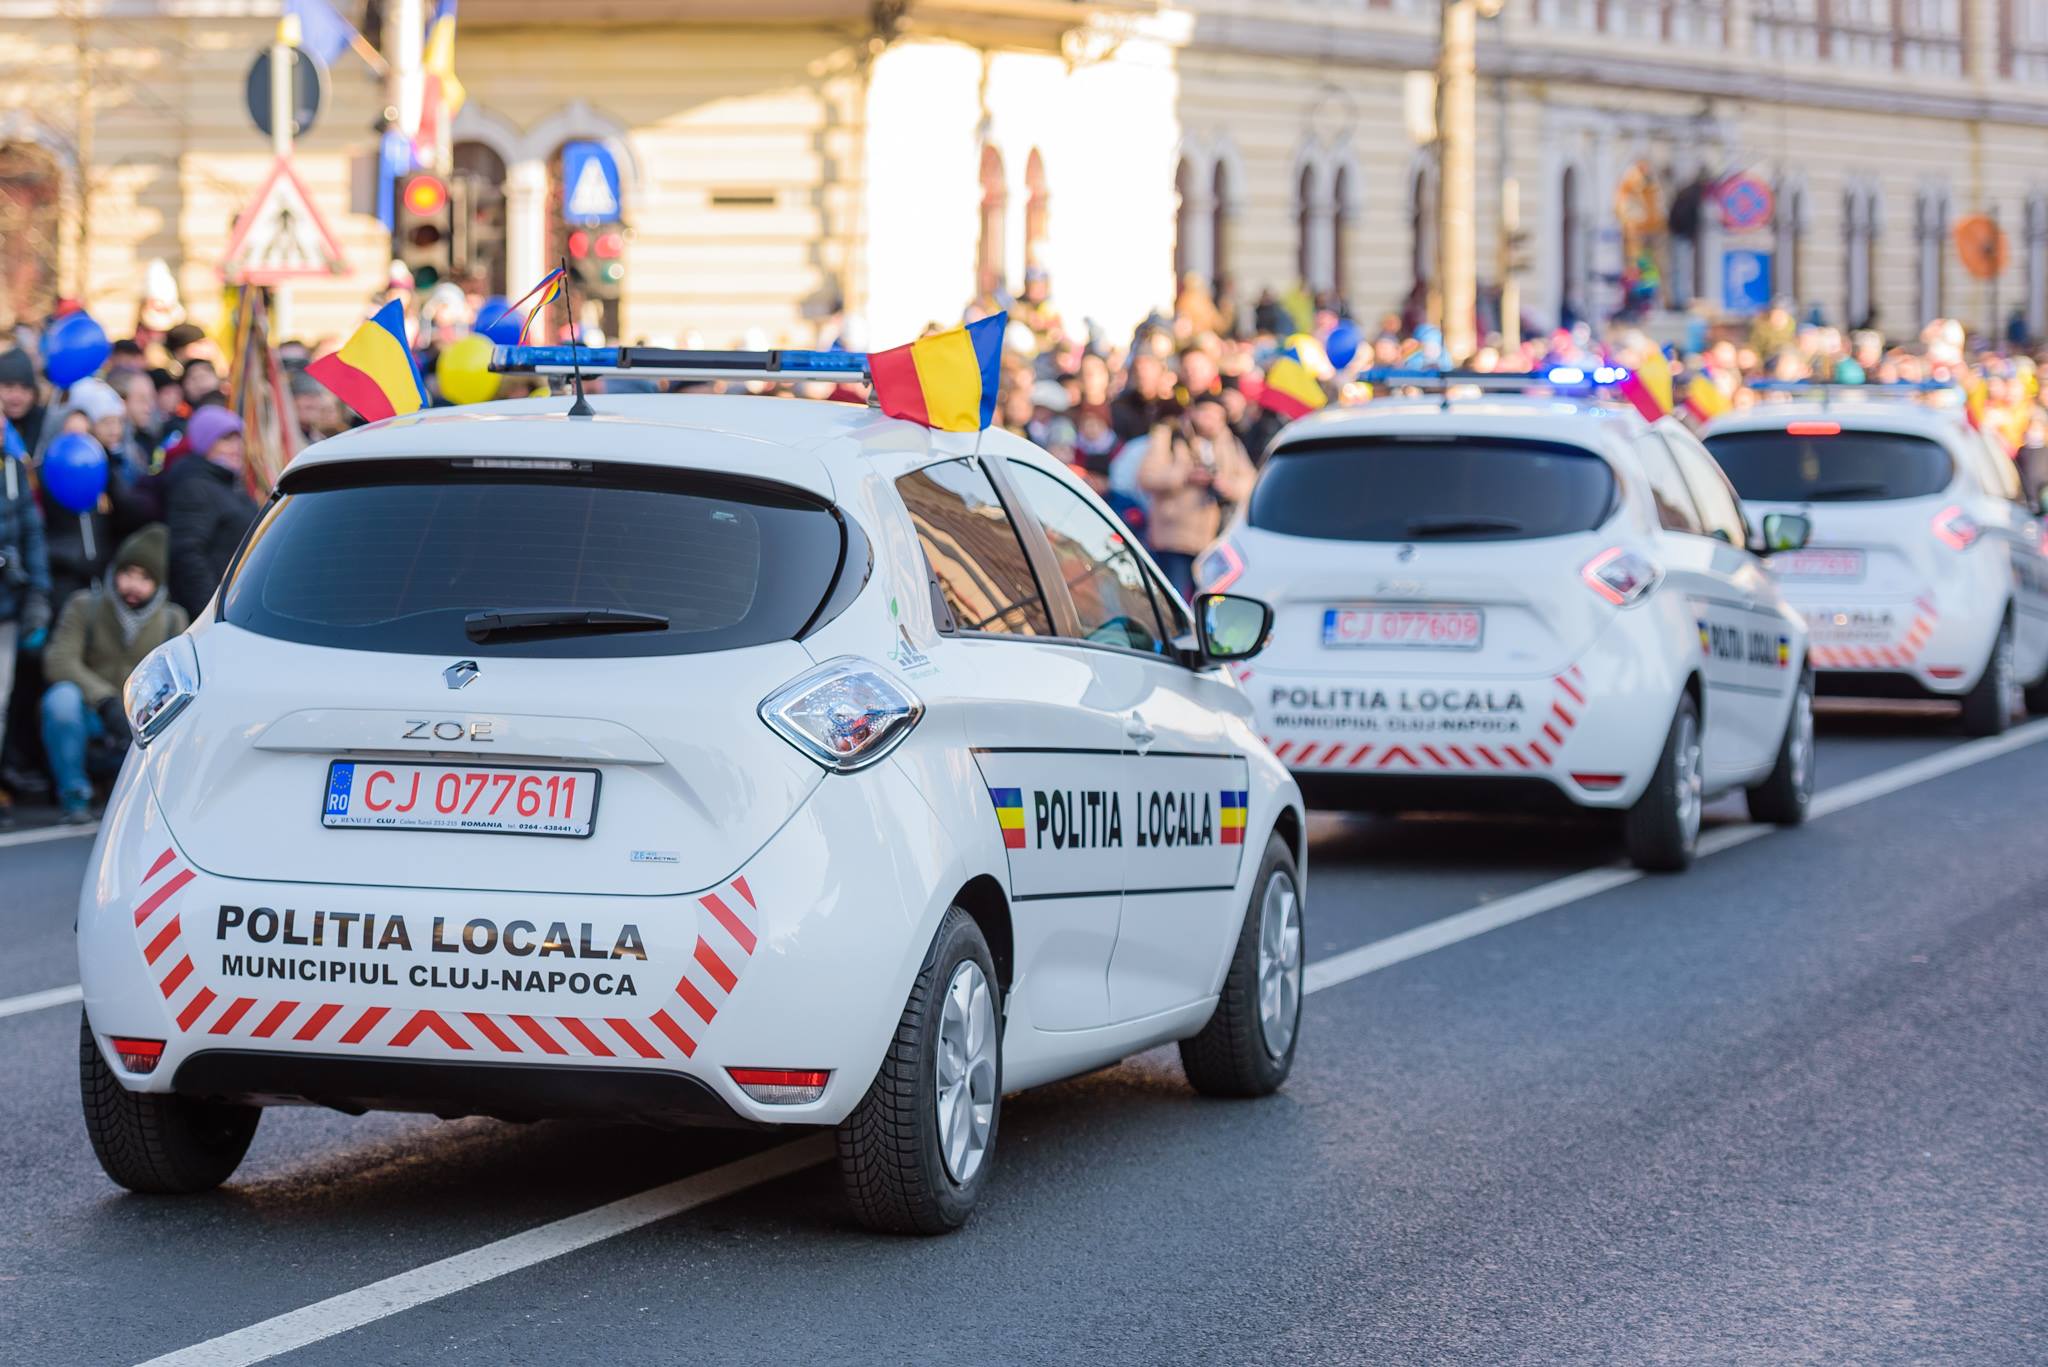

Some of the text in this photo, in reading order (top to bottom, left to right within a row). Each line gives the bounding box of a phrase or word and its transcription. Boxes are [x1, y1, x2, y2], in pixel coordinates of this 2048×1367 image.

[1338, 611, 1374, 640] CJ
[1381, 612, 1479, 641] 077609
[1271, 687, 1524, 712] POLITIA LOCALA
[401, 720, 494, 742] ZOE
[1274, 714, 1379, 730] MUNICIPIUL
[329, 793, 349, 811] RO
[364, 770, 577, 819] CJ 077611
[461, 820, 503, 829] ROMANIA
[1033, 789, 1213, 850] POLITIA LOCALA
[216, 904, 649, 961] POLITIA LOCALA
[221, 954, 638, 996] MUNICIPIUL CLUJ-NAPOCA
